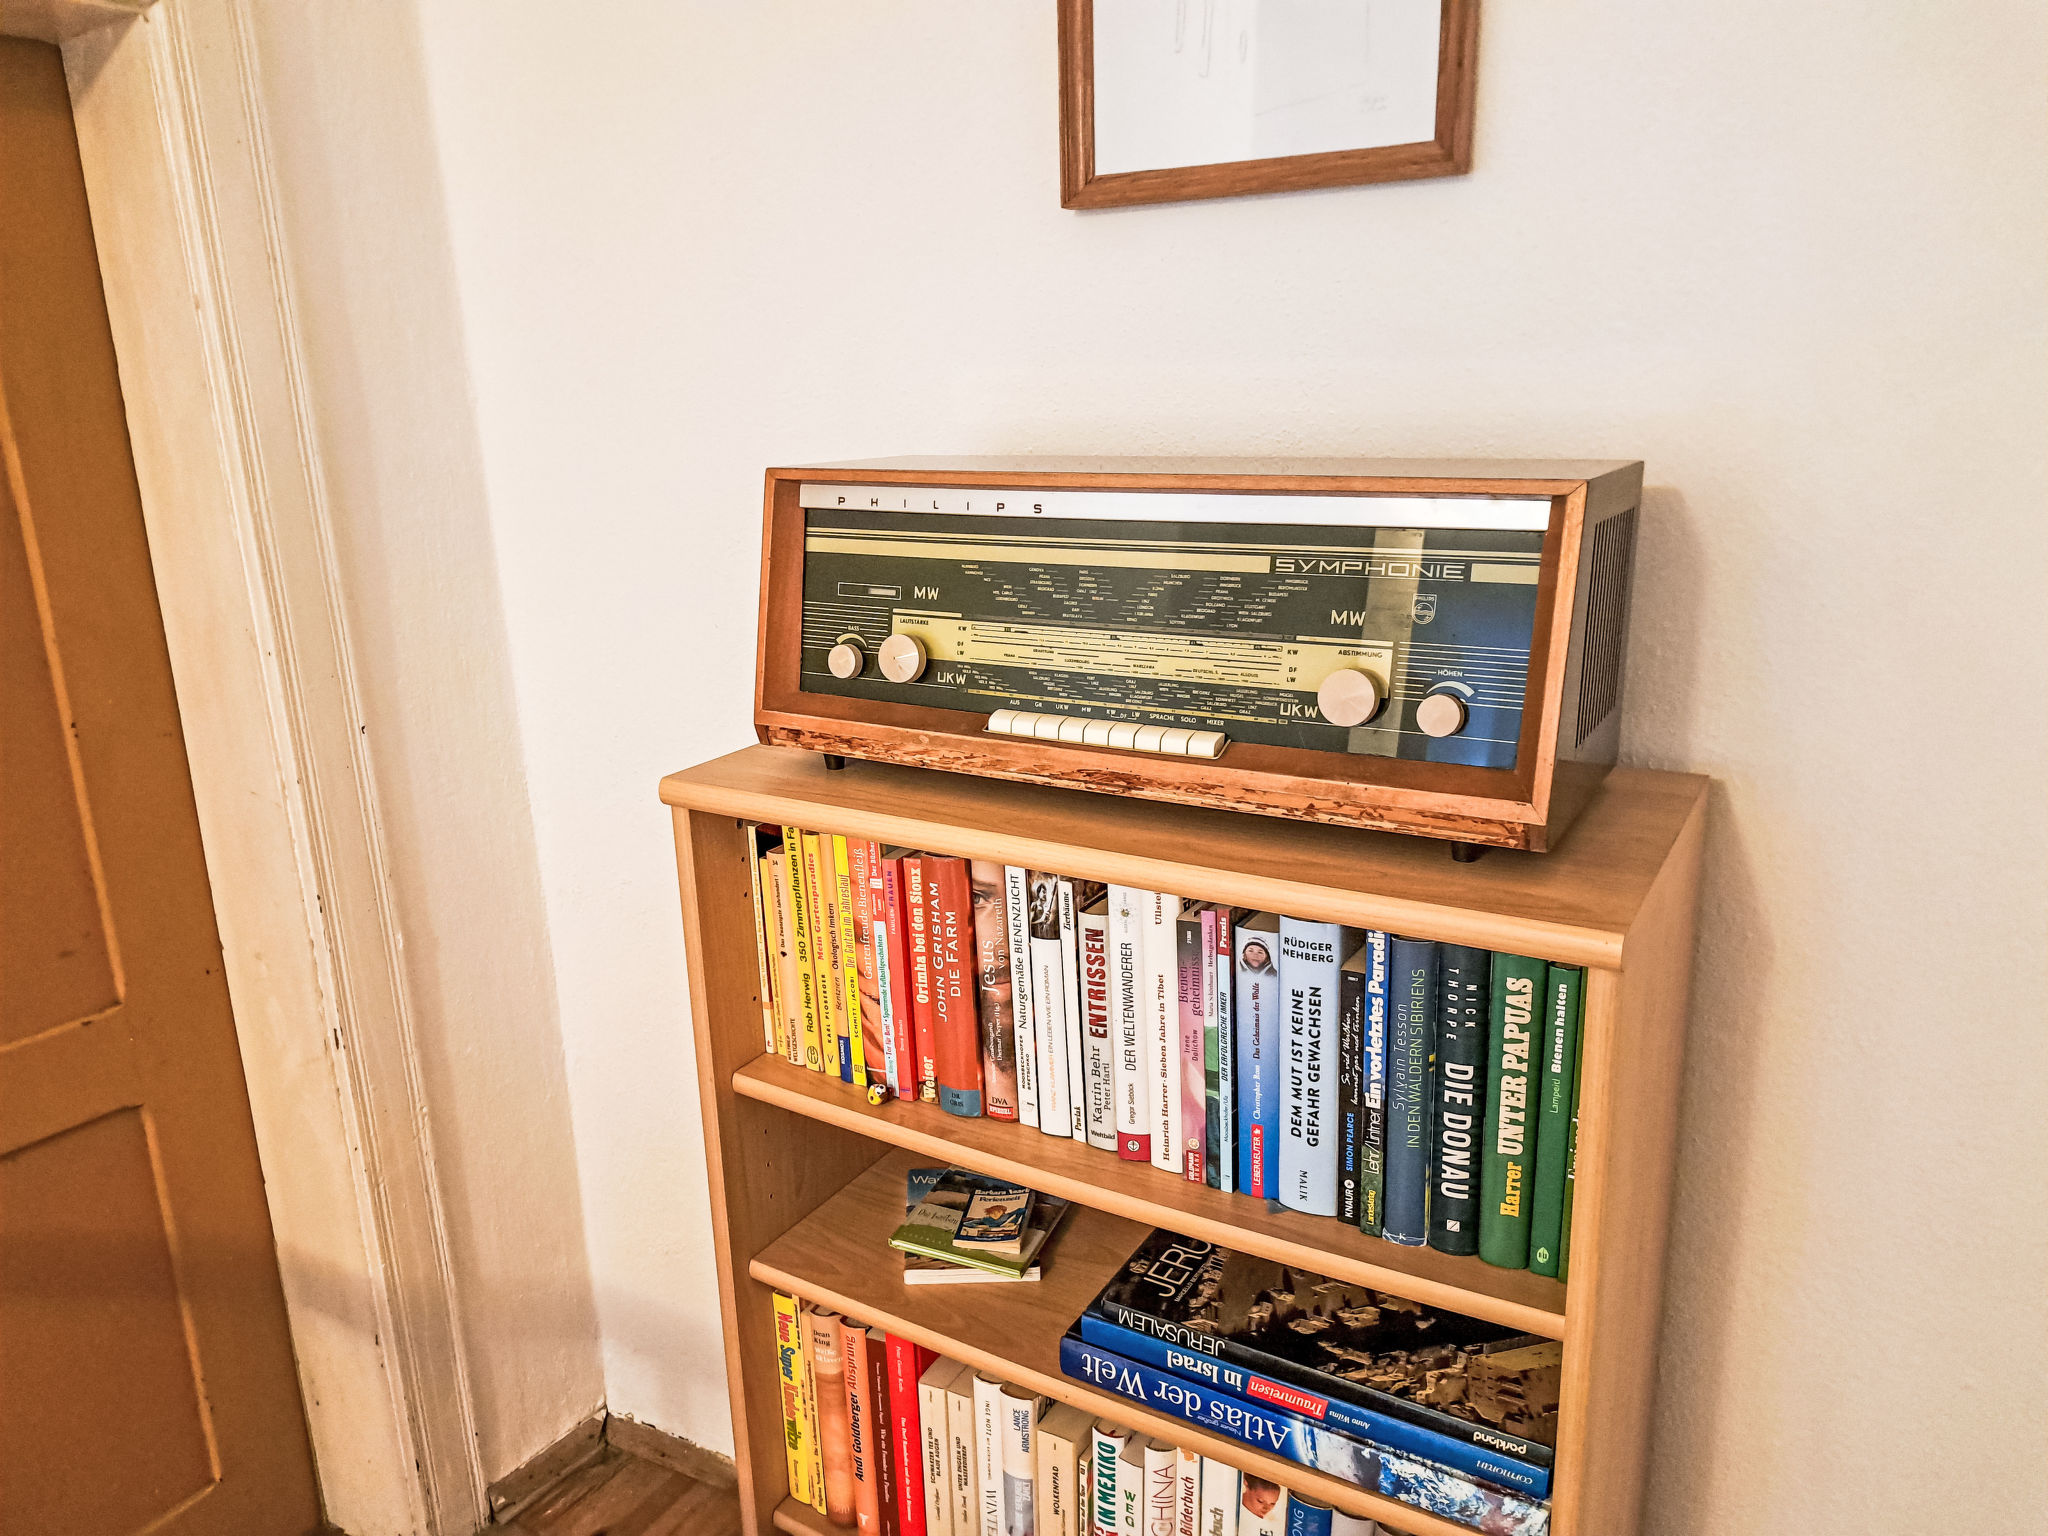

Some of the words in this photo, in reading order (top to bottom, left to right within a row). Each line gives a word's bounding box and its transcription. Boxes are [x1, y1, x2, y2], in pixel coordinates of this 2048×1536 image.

[838, 496, 1042, 514] PHILIPS
[1275, 558, 1465, 579] SYMPHONIE
[914, 586, 939, 600] MW
[1330, 609, 1366, 626] MW
[1338, 650, 1383, 659] ABSTIMMUNG
[936, 671, 967, 685] UKW
[1437, 669, 1464, 677] HÖHEN
[1149, 713, 1175, 721] SPRACHE
[1180, 716, 1197, 724] SOLO
[1279, 703, 1319, 718] UKW
[788, 843, 797, 852] in
[792, 854, 805, 938] Zimmerpflanzen
[808, 853, 821, 933] Gartenparadies
[838, 874, 851, 915] Jahreslauf
[909, 867, 923, 905] Sioux
[828, 903, 836, 928] Imkern
[843, 916, 853, 926] im
[911, 907, 924, 932] den
[929, 882, 945, 970] GRISHAM
[993, 897, 1004, 946] Nazareth
[1010, 873, 1024, 954] BIENENZUCHT
[1063, 891, 1071, 931] Zierbäume
[815, 936, 824, 961] Mein
[829, 927, 839, 970] Ökologisch
[844, 928, 854, 955] Garten
[859, 909, 872, 980] Gartenfreude
[912, 932, 926, 953] bei
[945, 911, 958, 963] FARM
[1207, 924, 1215, 967] Herbstgedanken
[1219, 917, 1227, 949] Praxis
[1284, 936, 1333, 952] RÜDIGER
[799, 941, 807, 962] 350
[846, 956, 856, 968] Der
[981, 940, 999, 996] Jesus
[997, 949, 1005, 969] von
[1282, 948, 1334, 963] NEHBERG
[801, 973, 811, 1009] Herwig
[914, 956, 929, 1004] Orimha
[949, 969, 961, 997] DIE
[1014, 957, 1028, 1030] Naturgemäße
[1085, 927, 1108, 1039] ENTRISSEN
[1121, 942, 1136, 1048] WELTENWANDERER
[1178, 961, 1189, 1004] Bienen-
[934, 976, 948, 1023] JOHN
[1159, 1002, 1165, 1012] in
[1291, 988, 1304, 1036] KEINE
[1352, 995, 1361, 1032] trinken
[1409, 968, 1426, 1035] SIBIRIENS
[1446, 968, 1460, 1040] THORPE
[1464, 984, 1478, 1028] NICK
[1554, 983, 1568, 1027] halten
[806, 1012, 814, 1033] Rob
[1159, 1014, 1167, 1043] Jahre
[1252, 1013, 1260, 1047] Geheimnis
[1307, 986, 1322, 1083] GEWACHSEN
[1365, 997, 1384, 1081] vorletztes
[1393, 1004, 1408, 1052] Tesson
[1501, 976, 1534, 1073] PAPUAS
[1192, 1028, 1200, 1062] Dalichow
[1220, 1014, 1229, 1067] ERFOLGREICHE
[1291, 1039, 1303, 1063] IST
[1551, 1028, 1565, 1074] Bienen
[922, 1055, 936, 1099] Weiser
[1090, 1045, 1101, 1080] Behr
[1125, 1050, 1137, 1071] DER
[1160, 1045, 1168, 1079] Sieben
[1220, 1067, 1229, 1082] DER
[1352, 1054, 1362, 1072] gar
[1160, 1083, 1169, 1118] Harrer
[1291, 1066, 1303, 1100] MUT
[1365, 1082, 1381, 1109] Ein
[1392, 1058, 1408, 1111] Sylvain
[1444, 1061, 1474, 1107] DIE
[991, 1096, 1008, 1106] DVA
[1074, 1105, 1082, 1131] Pawlak
[1091, 1081, 1103, 1124] Katrin
[1307, 1087, 1321, 1147] GEFAHR
[1497, 1074, 1528, 1156] UNTER
[1090, 1129, 1116, 1140] Weltbild
[1291, 1104, 1303, 1138] DEM
[1347, 1112, 1355, 1144] PEARCE
[1408, 1105, 1421, 1136] DEN
[1162, 1119, 1170, 1161] Heinrich
[1363, 1109, 1382, 1175] Lehr/Lintner
[1407, 1137, 1420, 1148] IN
[1440, 1111, 1473, 1200] DONAU
[1345, 1144, 1354, 1172] SIMON
[1299, 1169, 1308, 1202] MALIK
[1345, 1188, 1354, 1218] KNAUR
[1499, 1161, 1522, 1218] Harrer
[813, 1329, 831, 1338] Dean
[813, 1338, 831, 1347] King
[1118, 1308, 1226, 1357] JERUSALEM
[845, 1335, 857, 1389] Absprung
[1081, 1352, 1148, 1401] Welt
[1166, 1349, 1219, 1384] Israel
[1153, 1380, 1201, 1418] der
[1223, 1371, 1242, 1392] in
[1250, 1381, 1323, 1416] Traumreisen
[850, 1391, 863, 1454] Goldberger
[1012, 1408, 1021, 1432] LANCE
[1021, 1410, 1030, 1454] ARMSTRONG
[1209, 1400, 1292, 1450] Atlas
[1472, 1430, 1527, 1455] parkland
[854, 1455, 864, 1483] Andi
[1097, 1440, 1117, 1506] MEXIKO
[1476, 1460, 1533, 1485] cormoran
[1052, 1465, 1060, 1516] WOLKENPFAD
[1180, 1475, 1195, 1536] Bilderbuch
[1097, 1505, 1116, 1527] IN
